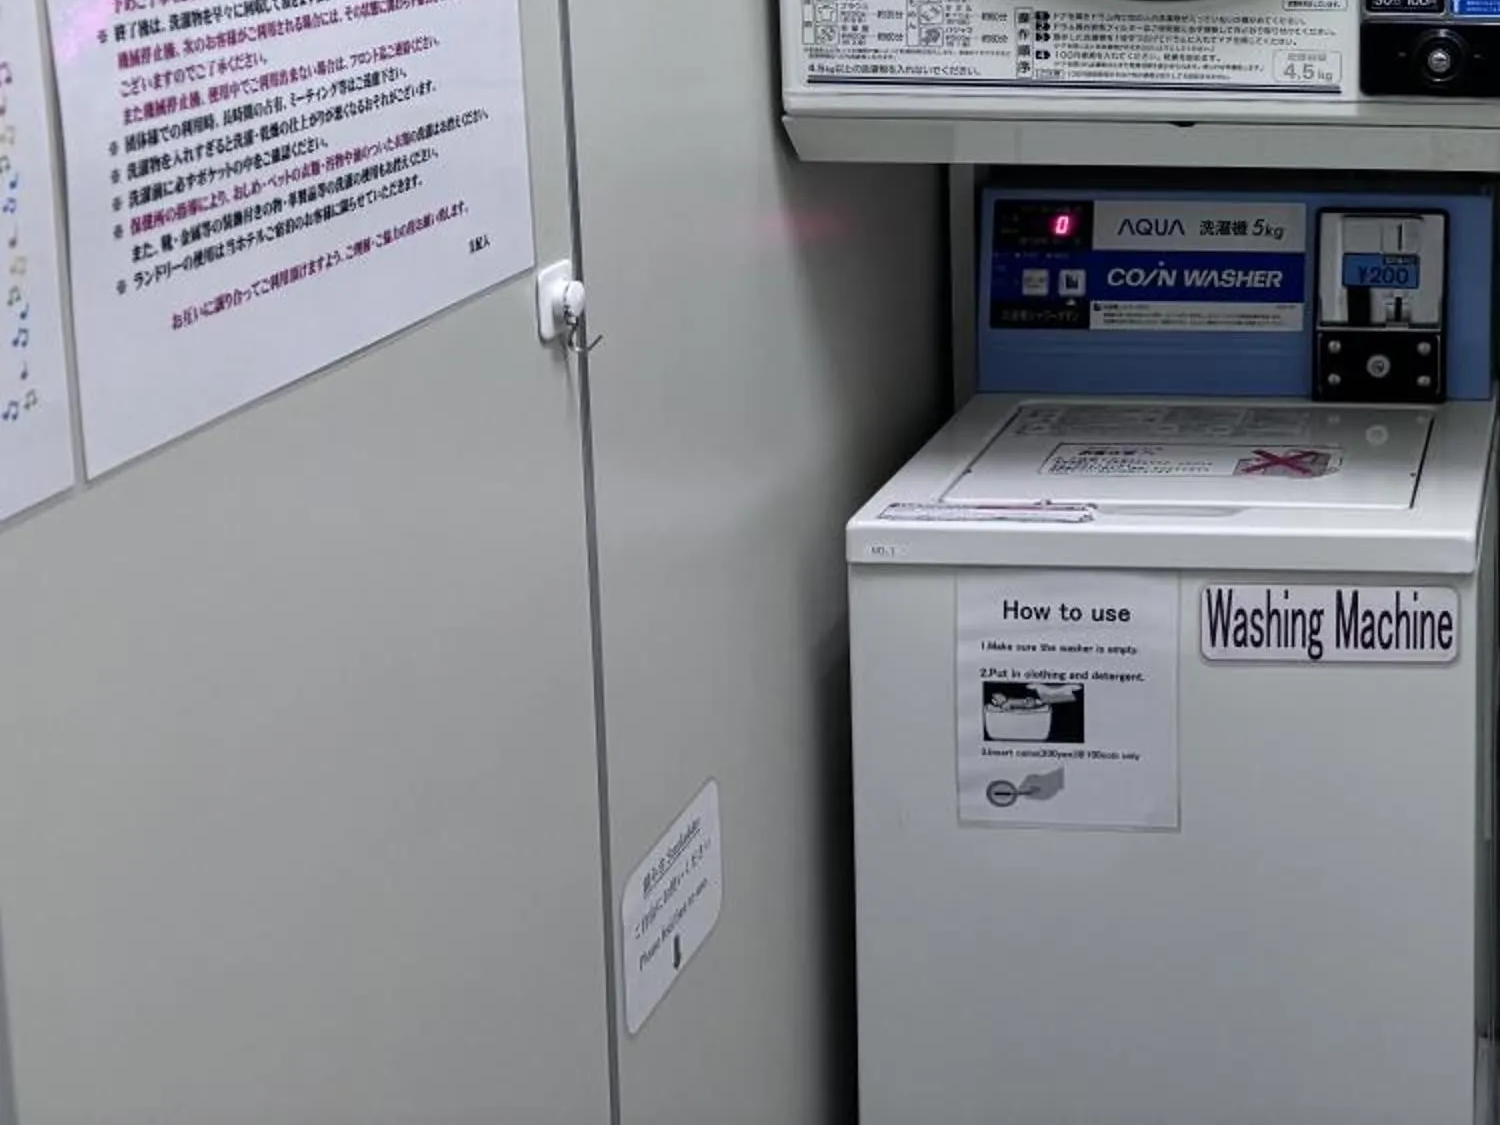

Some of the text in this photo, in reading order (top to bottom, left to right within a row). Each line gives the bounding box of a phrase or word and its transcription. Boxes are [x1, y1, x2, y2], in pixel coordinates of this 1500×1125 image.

[1054, 215, 1069, 235] 0
[1117, 218, 1285, 239] AQUA 洗濯機 5kg
[1183, 269, 1283, 289] WASHER
[1002, 600, 1132, 623] How to use
[1205, 587, 1454, 661] Washing Machine
[1069, 671, 1089, 681] and
